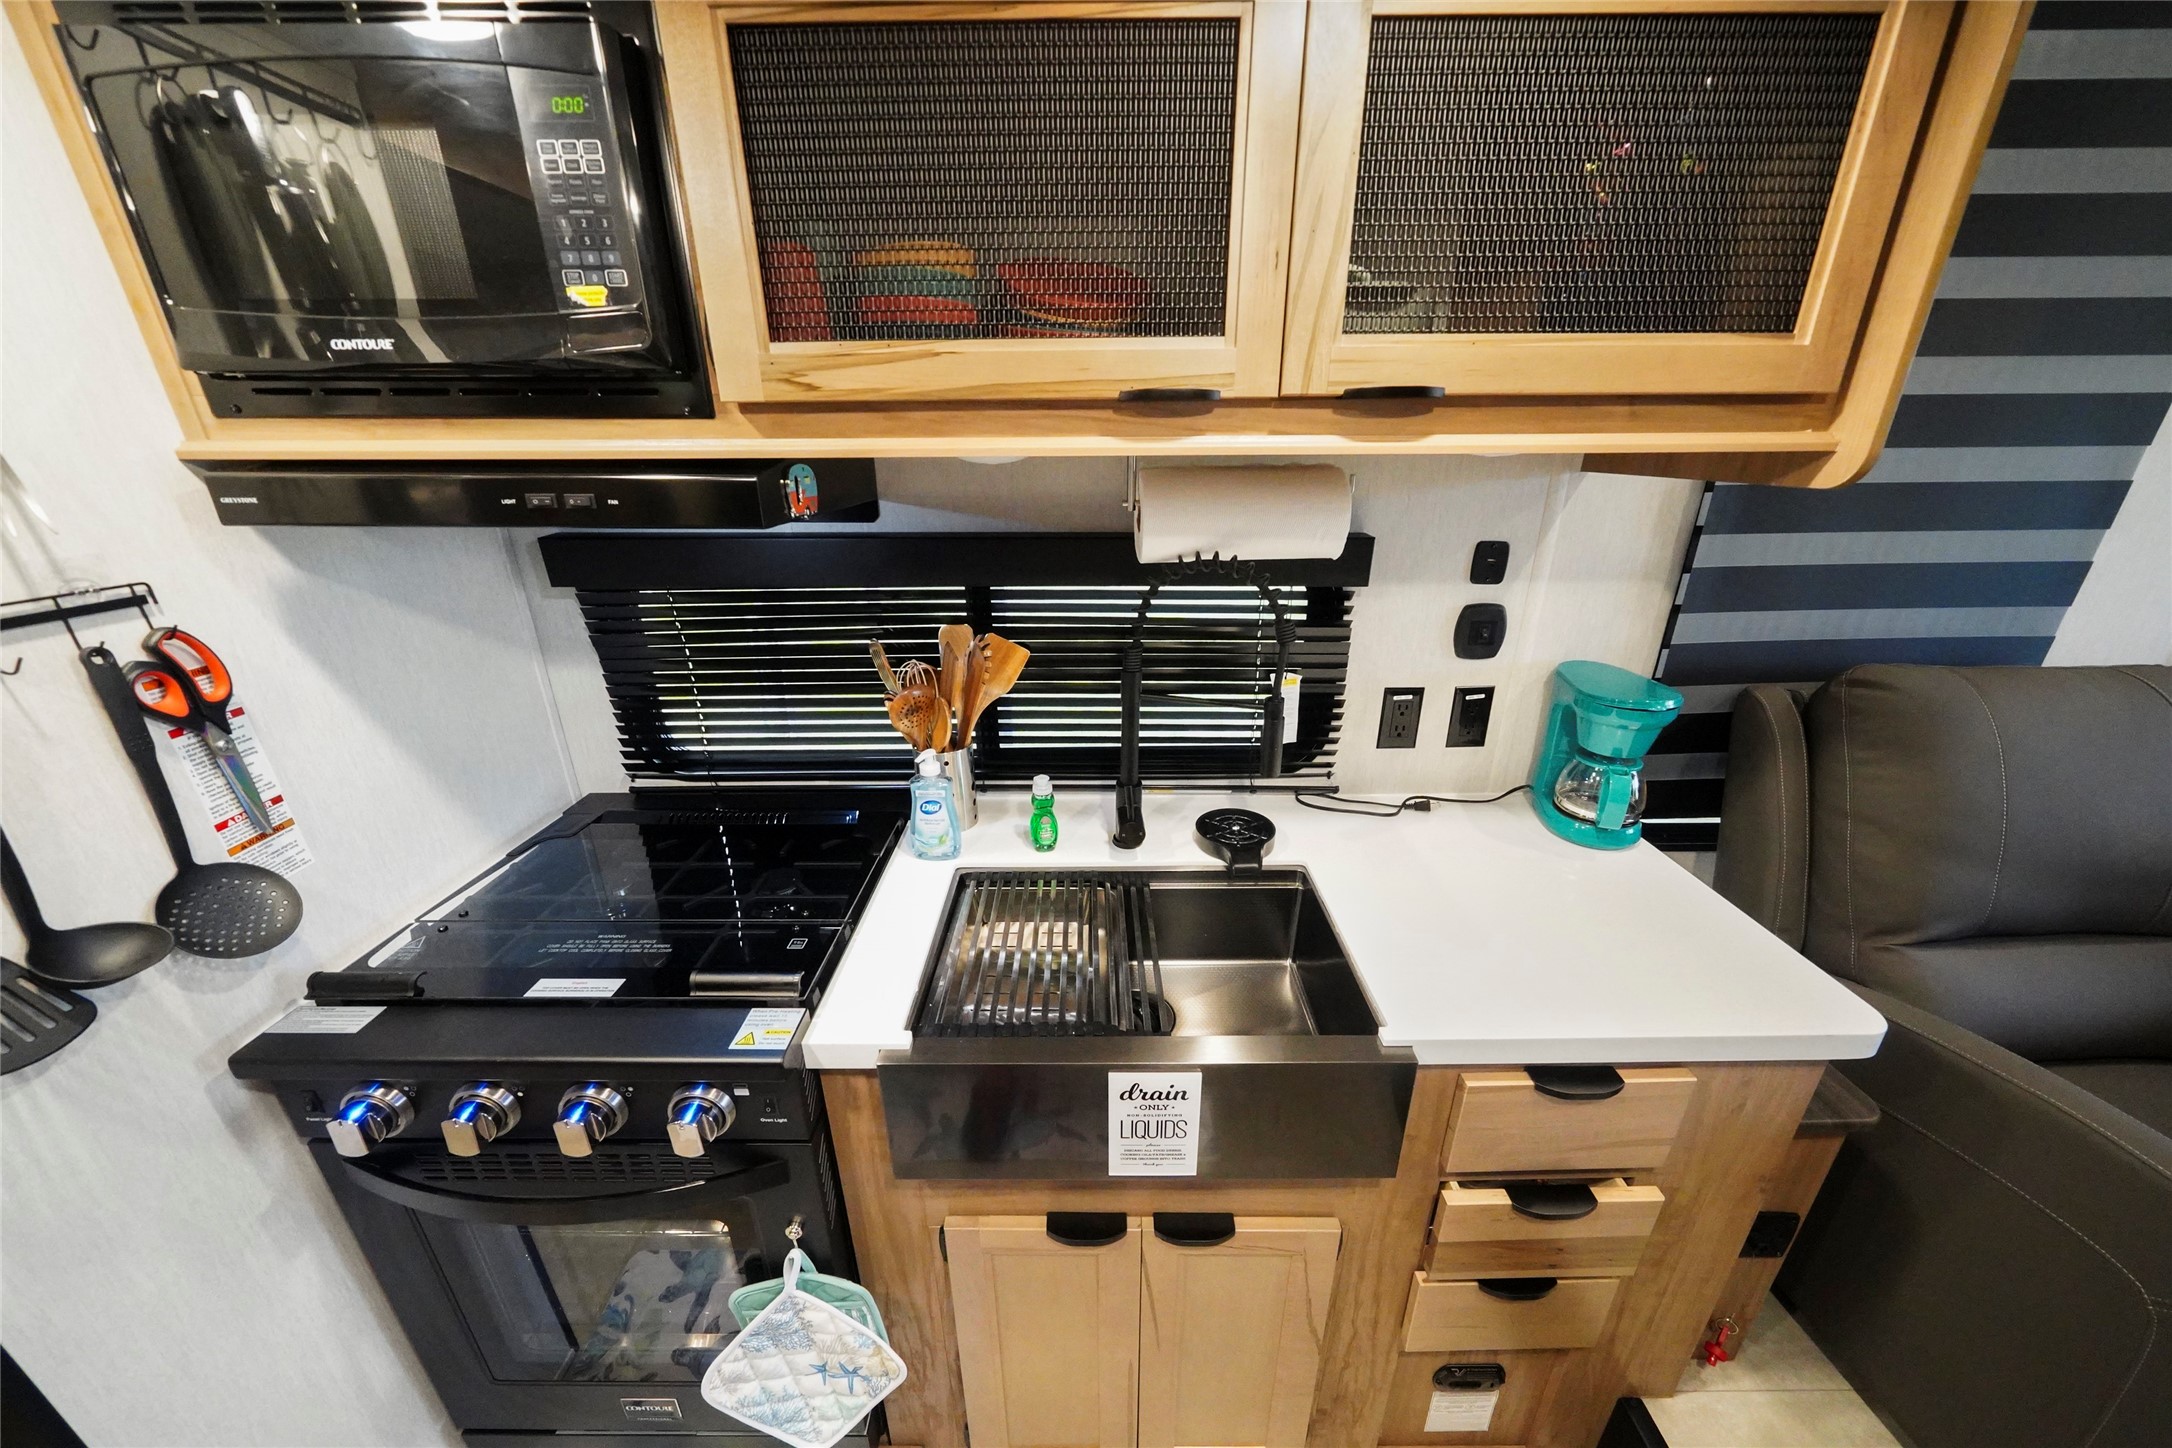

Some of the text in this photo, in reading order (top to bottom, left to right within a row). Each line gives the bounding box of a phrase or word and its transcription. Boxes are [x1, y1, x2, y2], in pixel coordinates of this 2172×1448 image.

[552, 96, 583, 113] 0:00
[581, 219, 587, 228] 2
[602, 219, 608, 228] 3
[584, 236, 591, 245] 5
[605, 236, 611, 245] 6
[921, 803, 942, 811] Dial
[1119, 1083, 1189, 1101] drain
[1120, 1120, 1188, 1139] LIQUIDS
